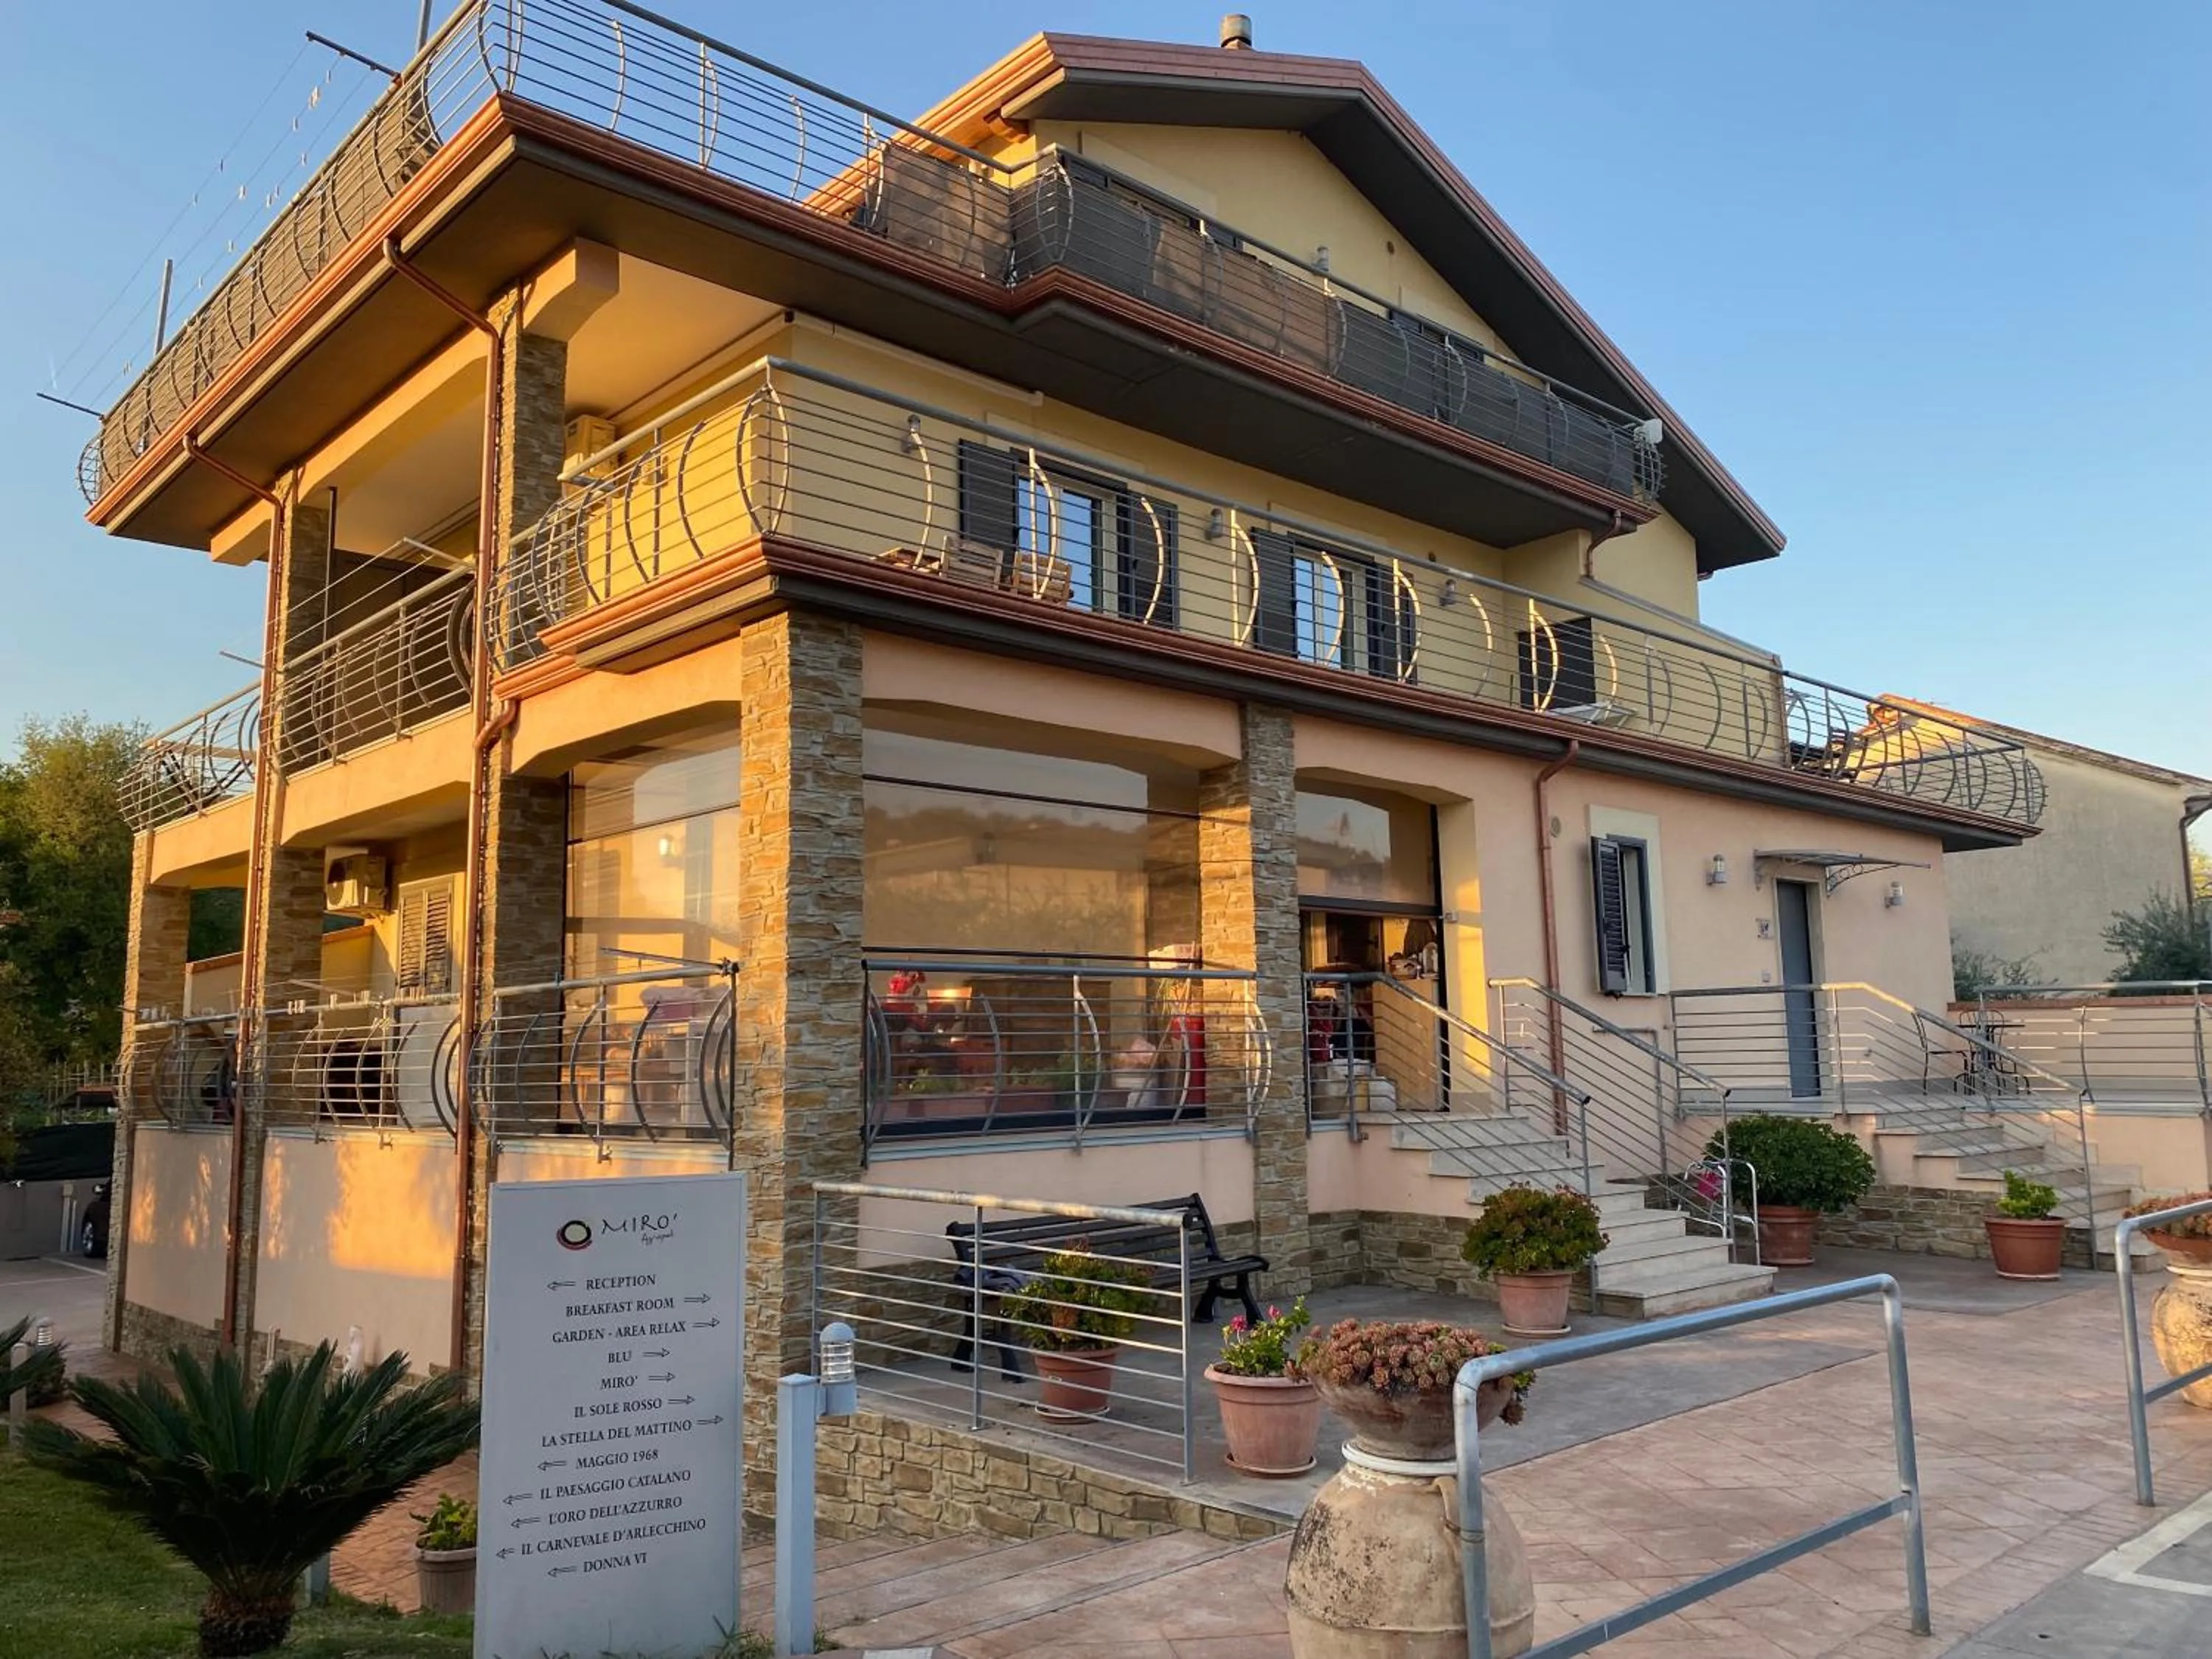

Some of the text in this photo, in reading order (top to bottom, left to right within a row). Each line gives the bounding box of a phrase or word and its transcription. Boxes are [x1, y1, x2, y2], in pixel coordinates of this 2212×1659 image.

[586, 1274, 655, 1290] RECEPTION
[566, 1298, 674, 1317] BREAKFAST ROOM
[553, 1329, 604, 1343] GARDEN
[615, 1325, 646, 1339] AREA
[650, 1321, 686, 1335] RELAX
[608, 1351, 631, 1363] BLU
[574, 1398, 662, 1418] IL SOLE ROSSO
[541, 1419, 692, 1447] LA STELLA DEL MATTINO
[575, 1450, 658, 1470] MAGGIO 1968
[540, 1470, 691, 1500] IL PAESAGGIO CATALANO
[549, 1497, 682, 1525] L'ORO DELL'AZZURRO
[521, 1519, 706, 1555] IL CARNEVALE D'ARLECCHINO
[583, 1552, 647, 1573] DONNA VI
